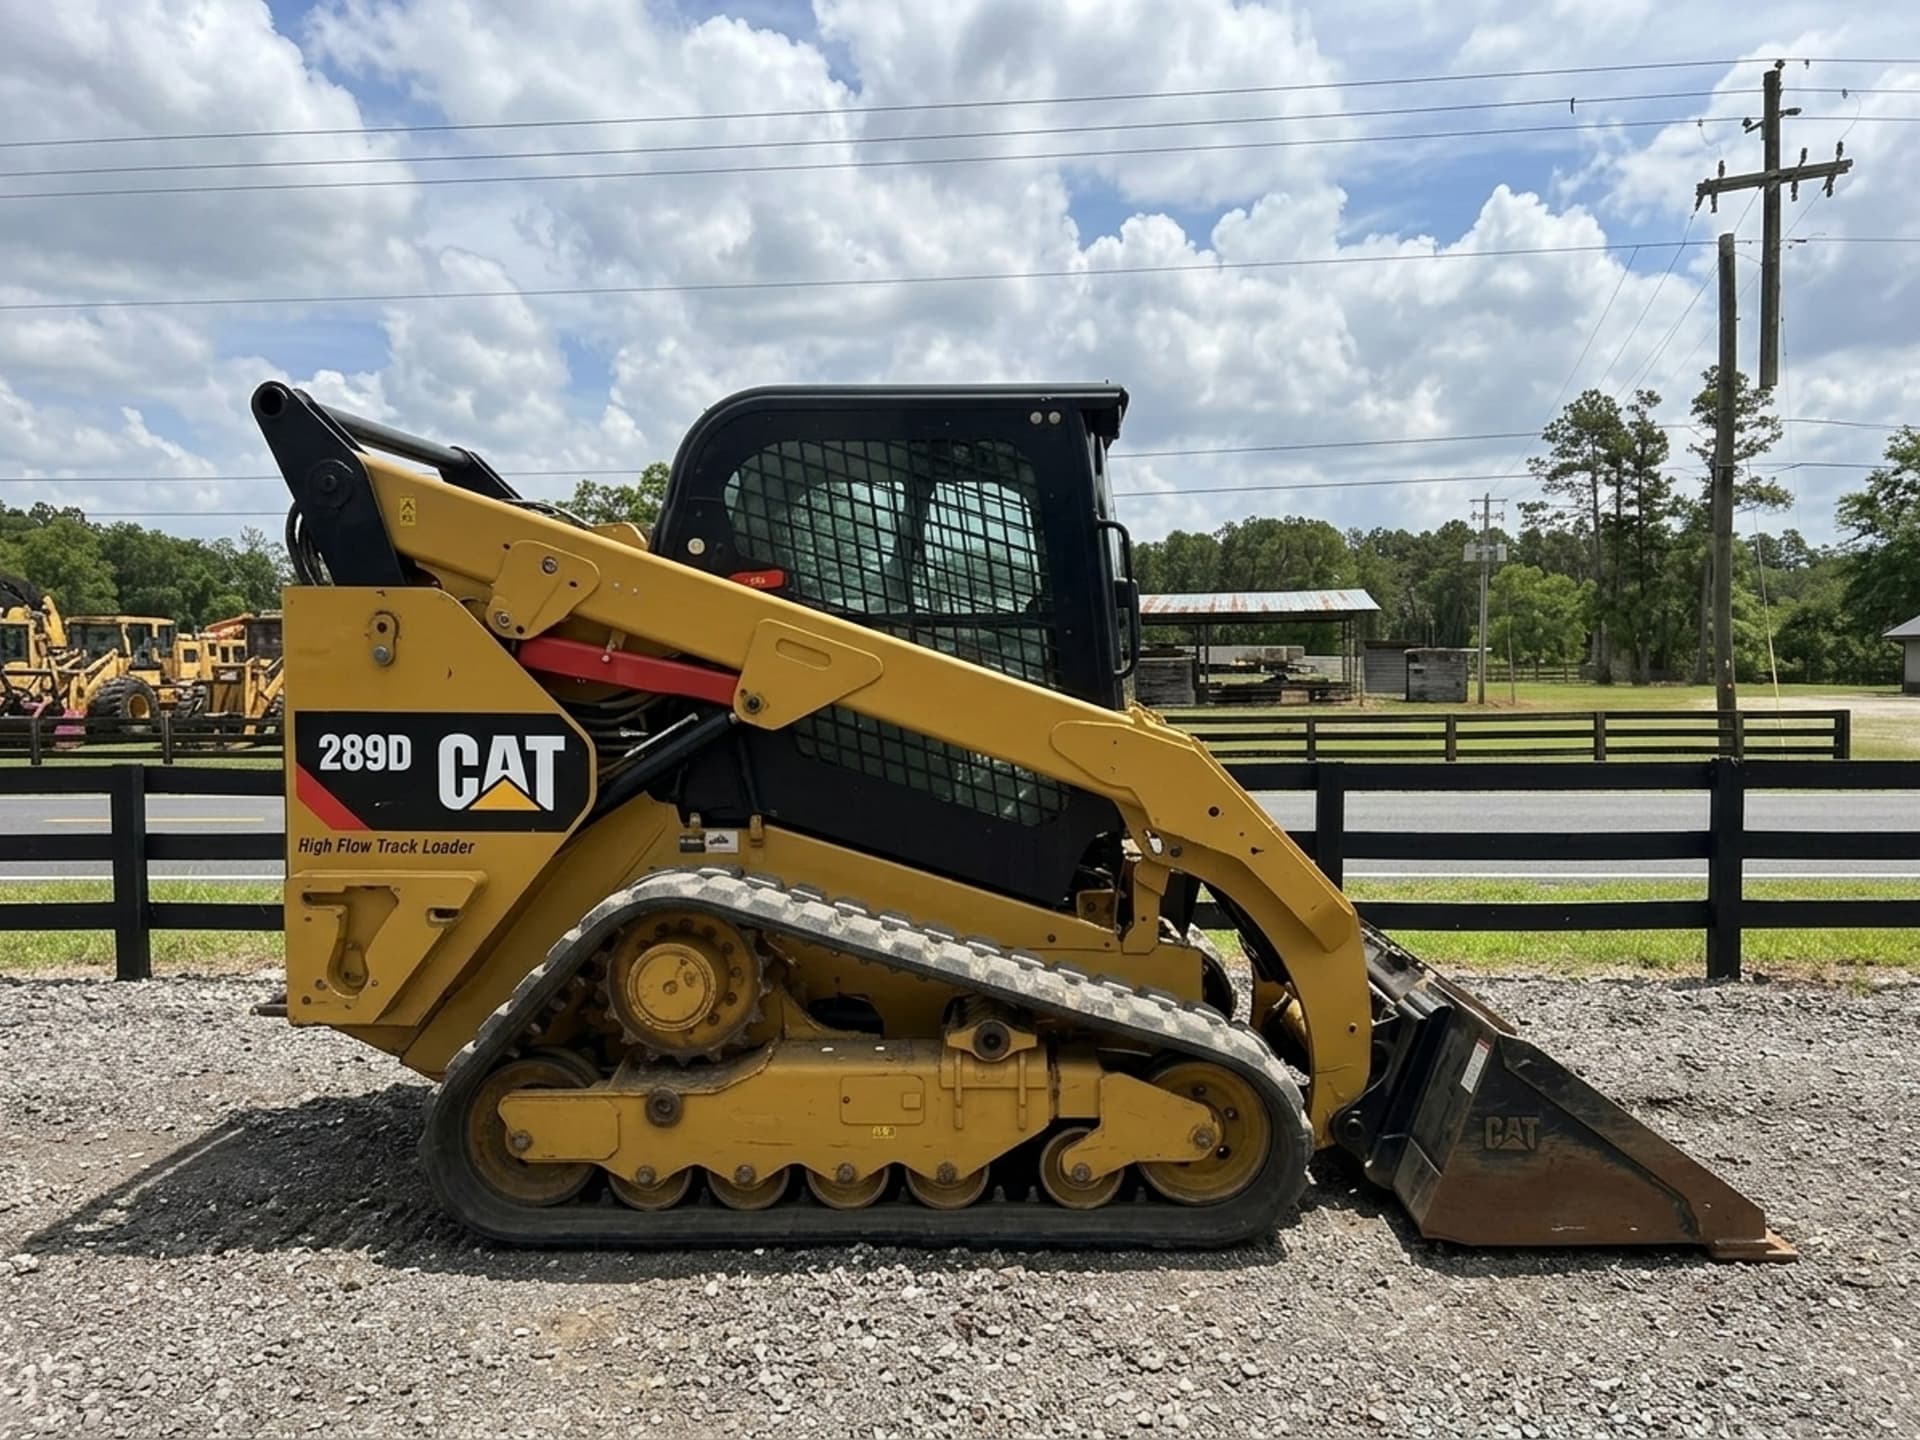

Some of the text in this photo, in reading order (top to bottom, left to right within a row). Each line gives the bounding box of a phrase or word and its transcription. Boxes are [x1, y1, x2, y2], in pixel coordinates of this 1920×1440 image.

[318, 733, 412, 771] 289D
[438, 733, 566, 811] CAT
[298, 838, 475, 856] High Flow Track Loader
[1485, 1116, 1539, 1150] CAT
